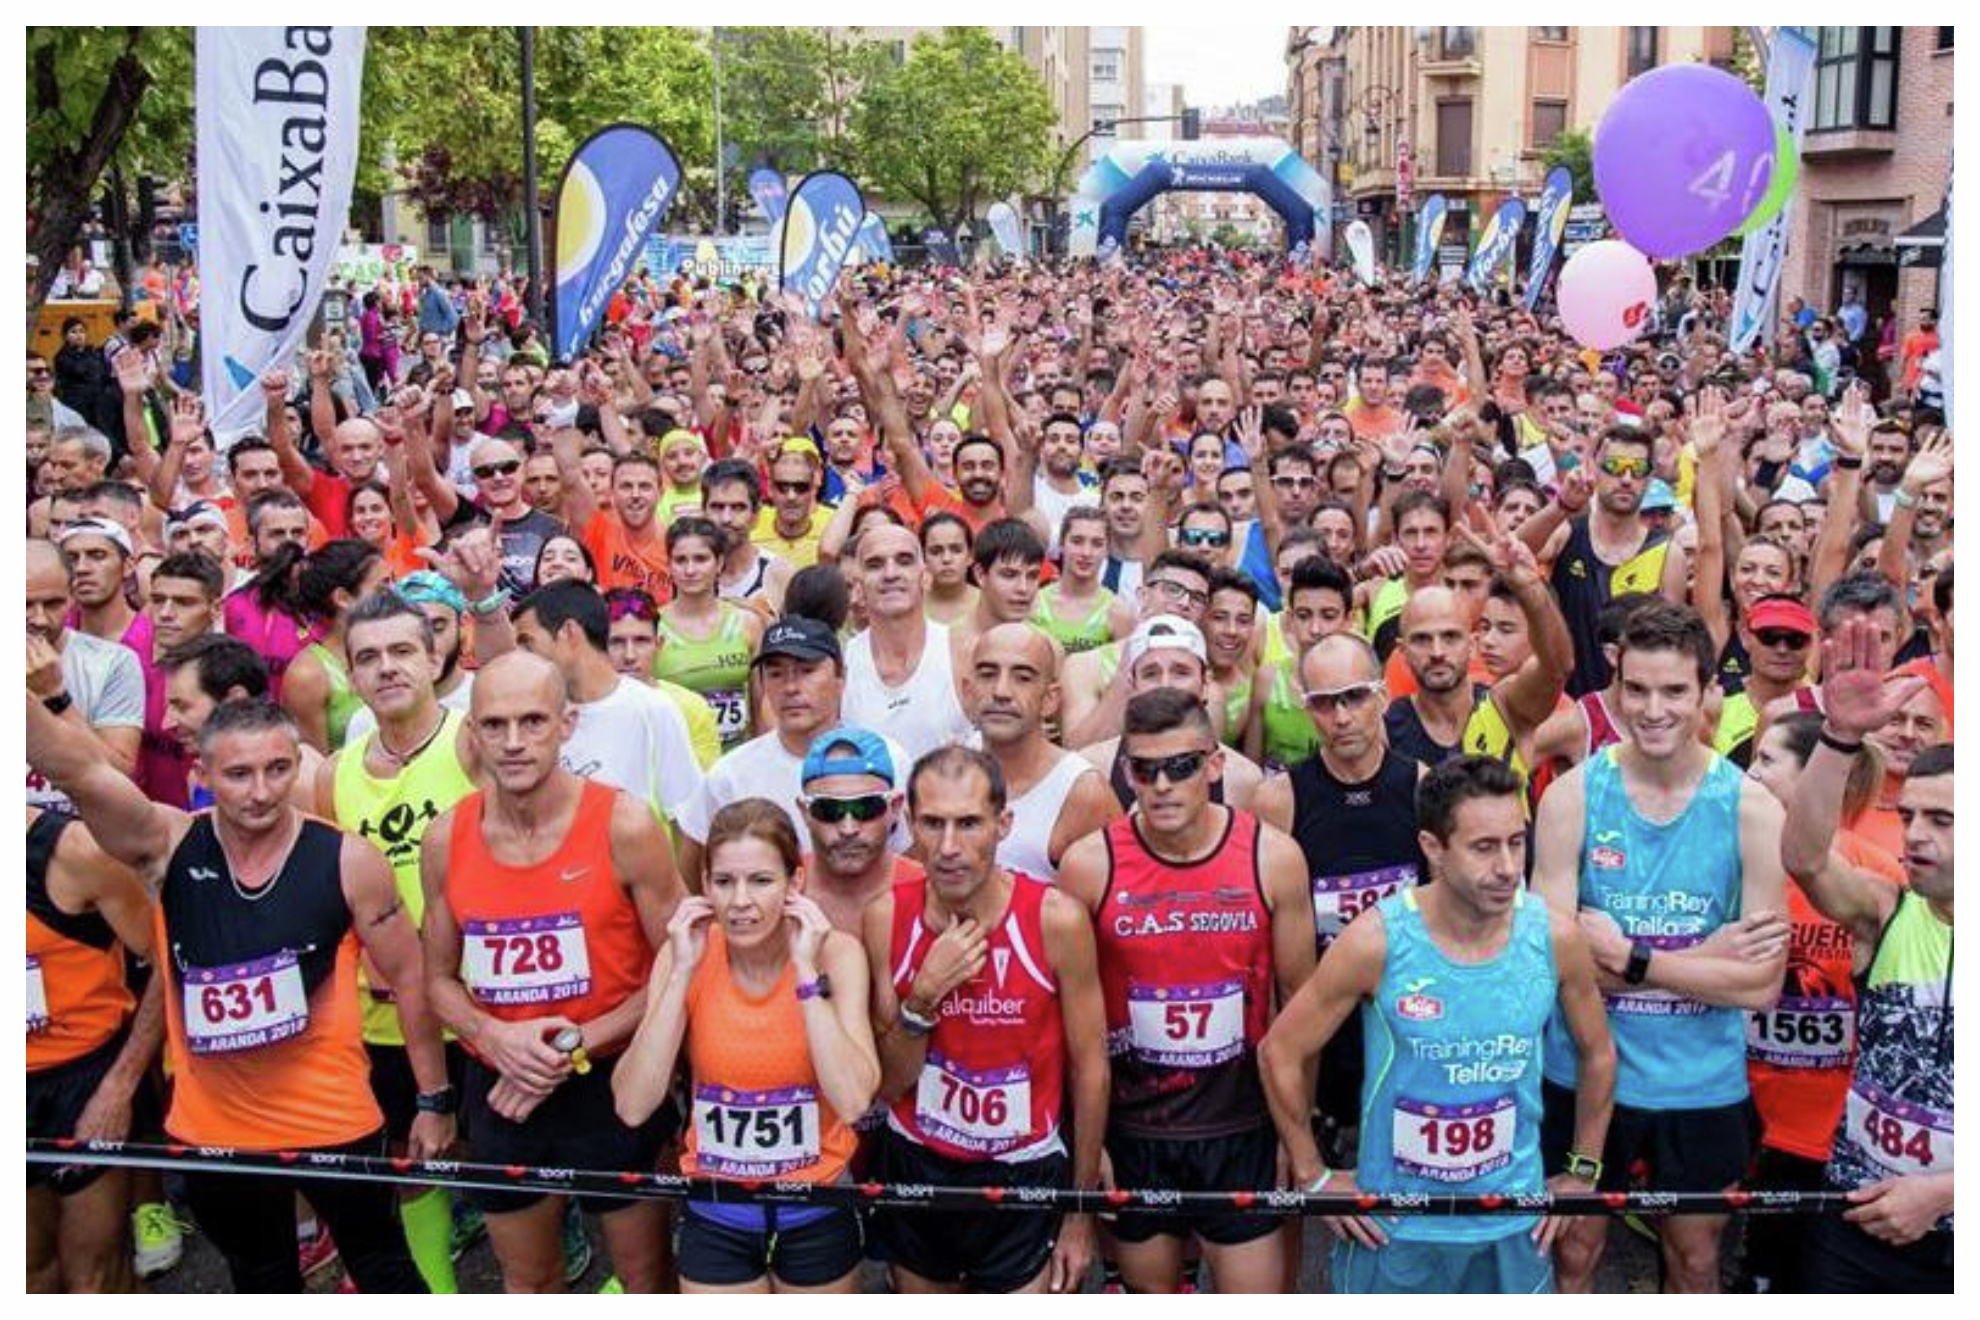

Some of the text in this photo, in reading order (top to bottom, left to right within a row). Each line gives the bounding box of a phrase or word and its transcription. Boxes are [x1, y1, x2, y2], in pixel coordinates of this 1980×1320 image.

[1190, 911, 1258, 932] SEGOVIA
[484, 934, 563, 975] 728
[202, 976, 276, 1024] 631
[494, 988, 549, 1004] ARANDA
[942, 989, 1026, 1016] alquiber
[210, 1029, 267, 1051] ARANDA
[1165, 1003, 1214, 1040] 57
[1752, 1013, 1844, 1046] 1563
[940, 1073, 1008, 1126] 706
[706, 1105, 804, 1148] 1751
[1420, 1118, 1495, 1156] 198
[1864, 1108, 1934, 1167] 484
